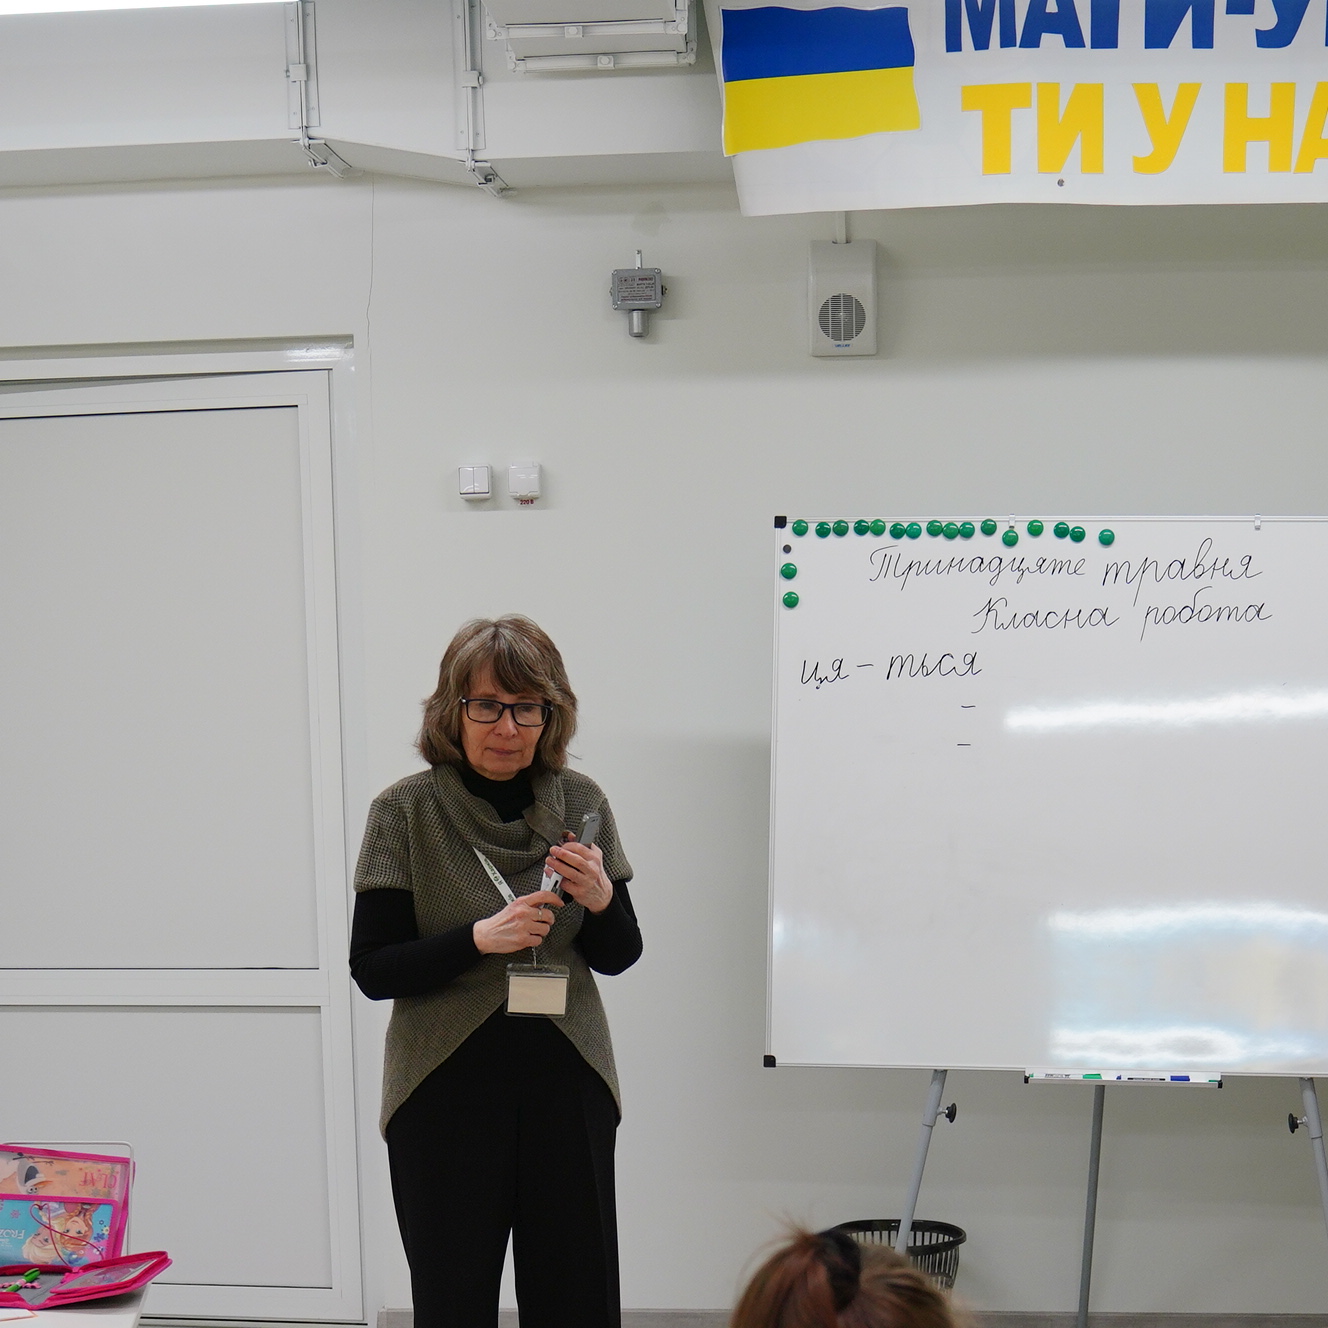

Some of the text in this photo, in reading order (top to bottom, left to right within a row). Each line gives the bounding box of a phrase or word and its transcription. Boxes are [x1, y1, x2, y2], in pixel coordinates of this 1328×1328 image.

[961, 82, 1104, 175] ТИ
[1132, 82, 1202, 174] У
[869, 538, 1263, 606] Тринадцяте травня
[971, 586, 1274, 641] Класна робота
[886, 650, 984, 681] ться
